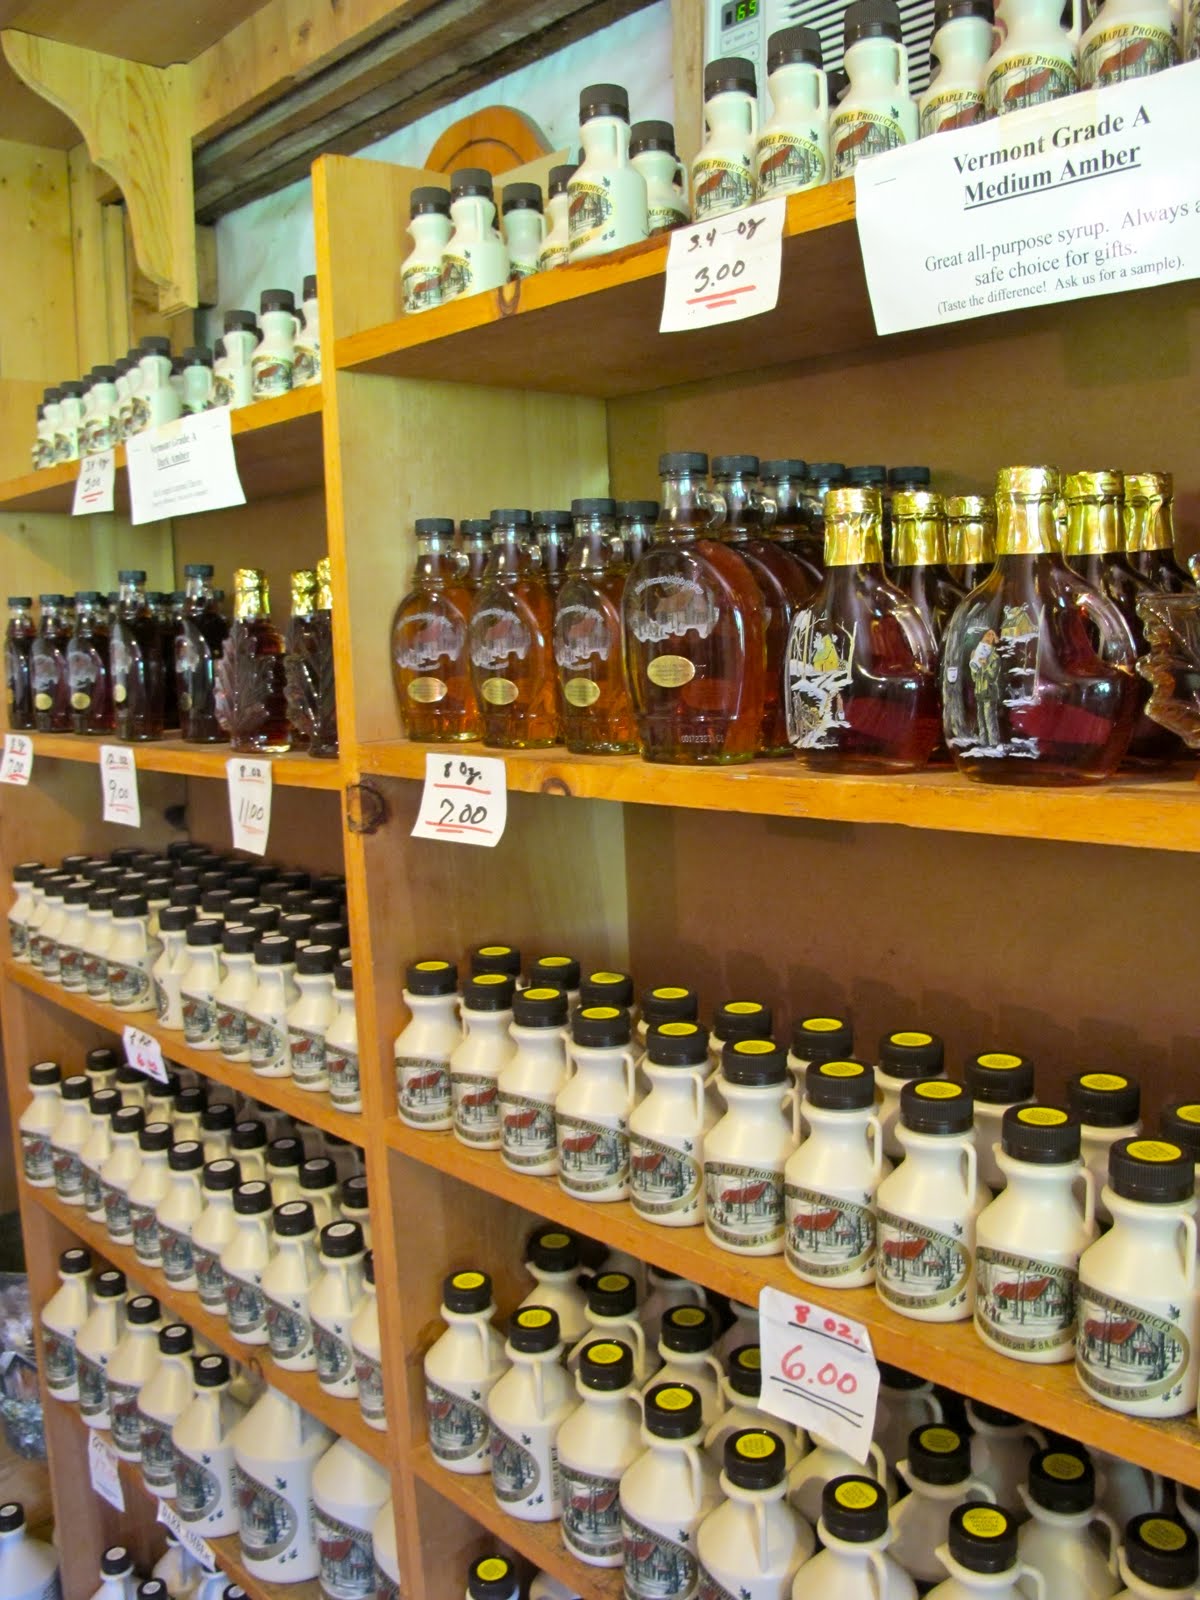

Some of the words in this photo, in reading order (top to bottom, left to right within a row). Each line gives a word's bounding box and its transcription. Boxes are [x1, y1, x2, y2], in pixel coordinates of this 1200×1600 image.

[1003, 57, 1033, 73] MAPLE
[937, 92, 963, 104] MAPLE
[856, 111, 898, 130] PRODUCTS
[778, 134, 817, 153] PRODUCTS
[953, 136, 1045, 175] Vermont
[1052, 113, 1125, 149] Grade
[1132, 105, 1151, 128] A
[964, 168, 1052, 205] Medium
[1059, 144, 1142, 180] Amber
[688, 229, 717, 253] 3.4
[924, 253, 964, 273] Great
[967, 232, 1053, 262] all-purpose
[1058, 221, 1110, 243] syrup.
[1121, 199, 1189, 230] Always
[694, 260, 746, 293] 3.00
[975, 267, 1004, 287] safe
[1008, 257, 1060, 281] choice
[1065, 248, 1090, 270] for
[1094, 240, 1138, 266] gifts.
[937, 296, 967, 315] (Taste
[968, 293, 985, 308] the
[987, 280, 1047, 304] difference!
[1054, 275, 1078, 291] Ask
[1082, 273, 1096, 285] us
[1099, 266, 1117, 283] for
[1120, 266, 1127, 278] a
[1130, 256, 1185, 277] sample).
[444, 761, 453, 778] 8
[440, 798, 488, 825] 7.00
[906, 1221, 957, 1248] PRODUCTS
[991, 1251, 1024, 1269] MAPLE
[794, 1304, 811, 1324] 8
[1113, 1299, 1174, 1333] PRODUCTS
[781, 1344, 858, 1395] 6.00
